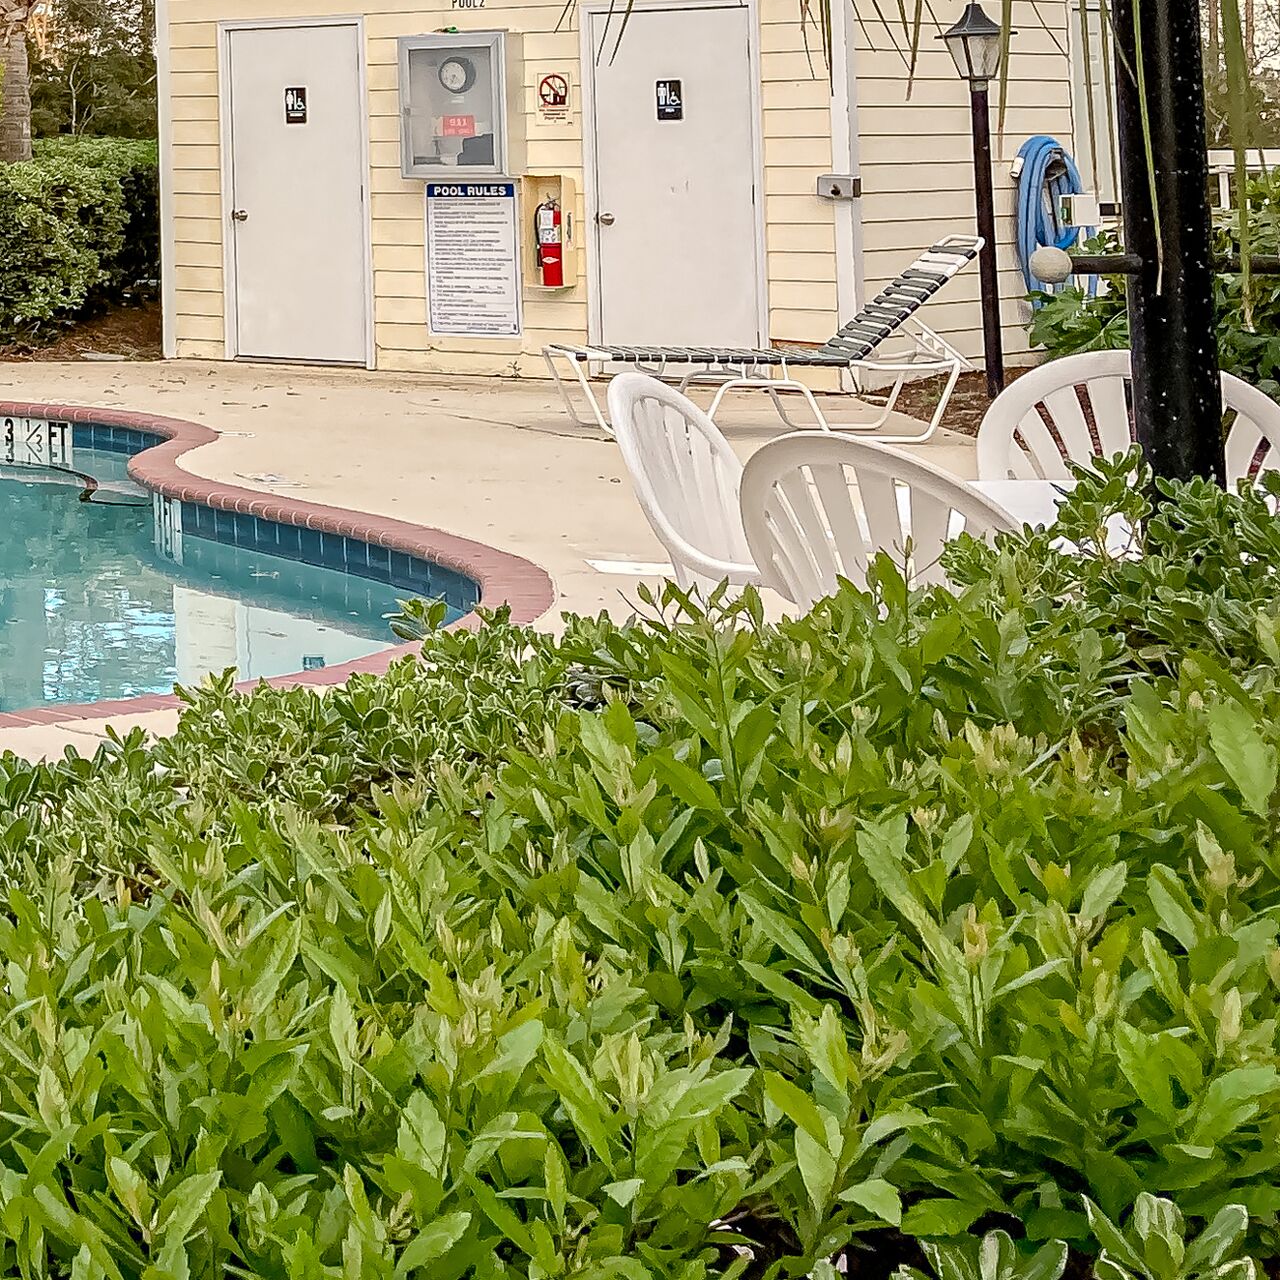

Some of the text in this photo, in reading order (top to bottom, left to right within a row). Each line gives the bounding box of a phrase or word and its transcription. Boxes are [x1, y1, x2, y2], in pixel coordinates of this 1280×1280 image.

[433, 186, 507, 196] POOL RULES
[4, 418, 14, 443] 3
[48, 421, 68, 446] FT
